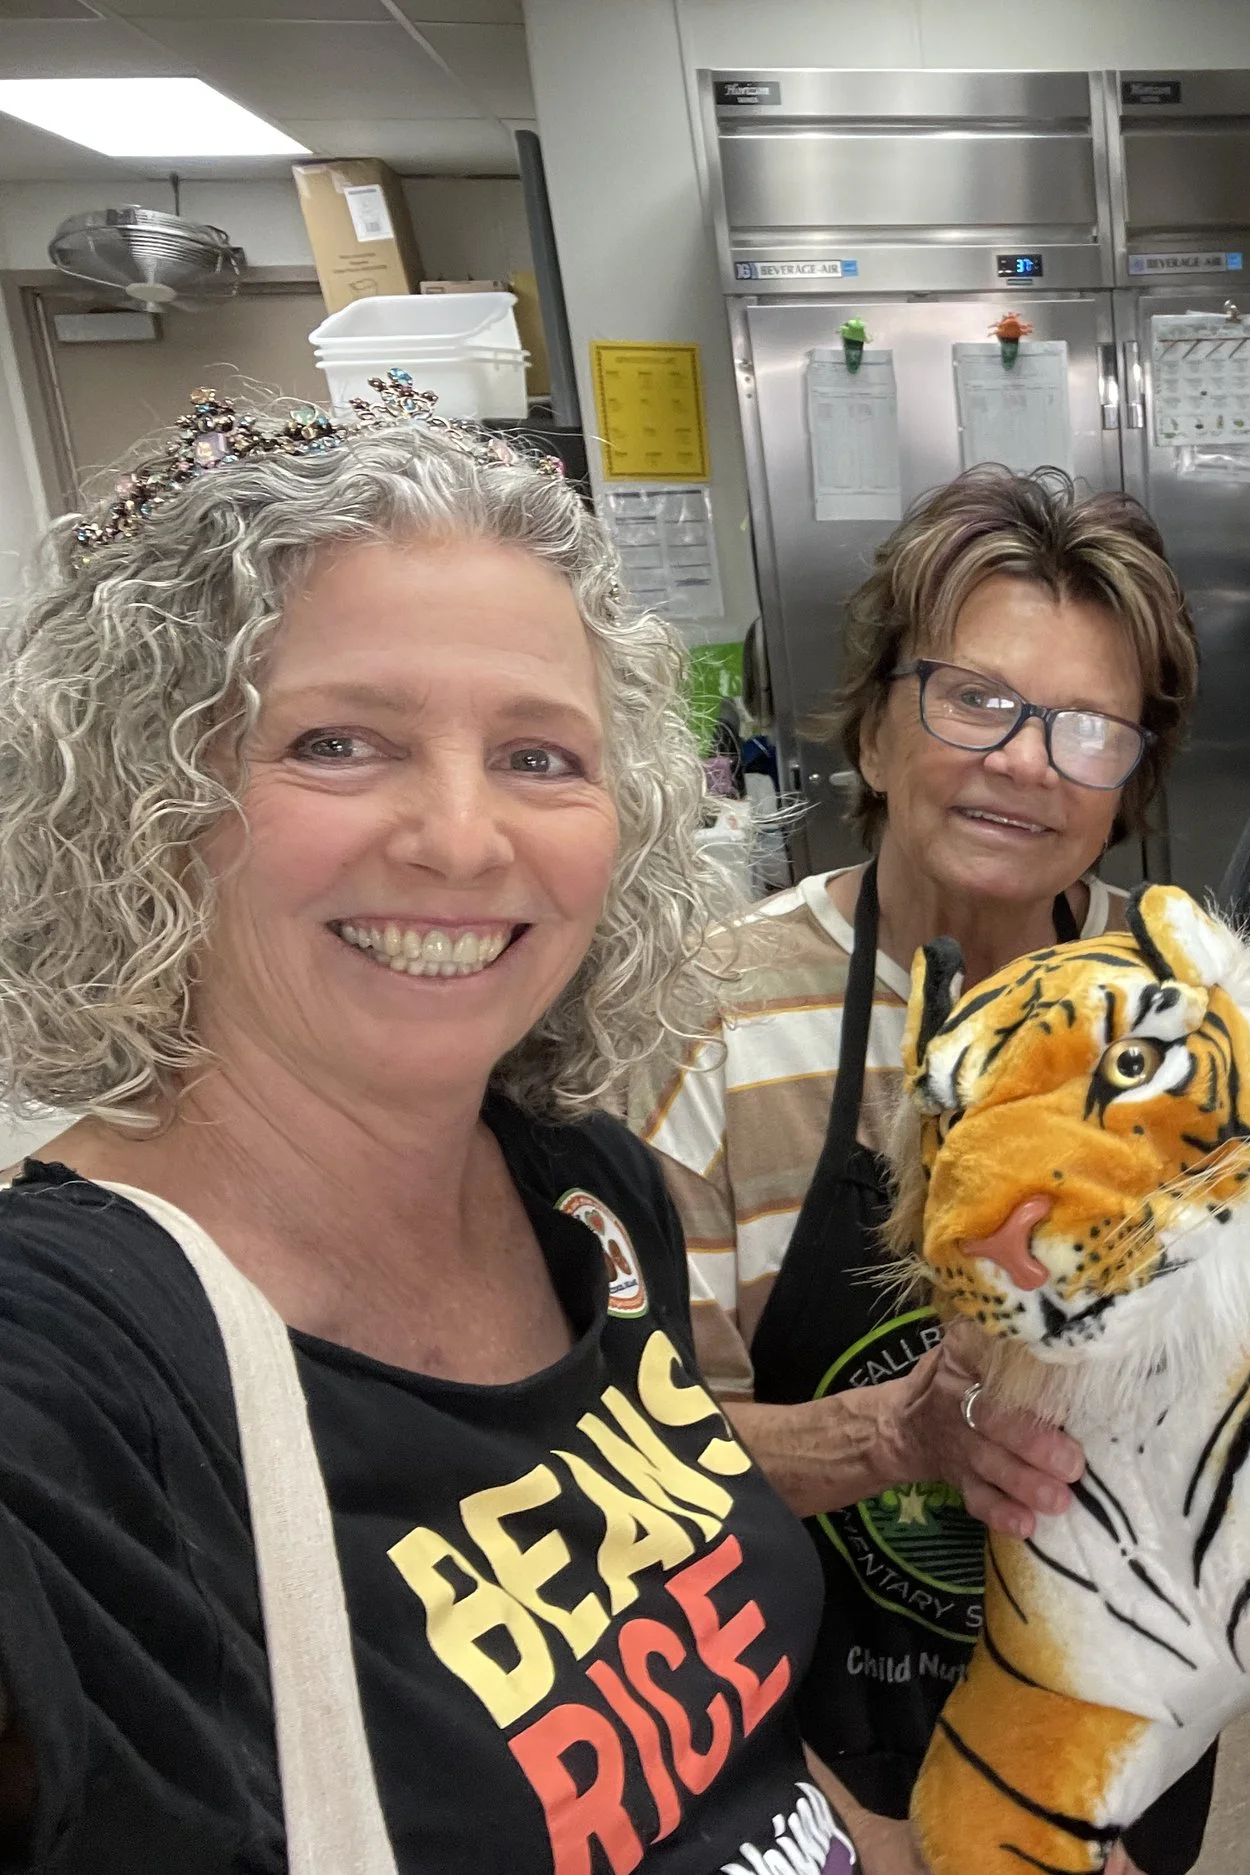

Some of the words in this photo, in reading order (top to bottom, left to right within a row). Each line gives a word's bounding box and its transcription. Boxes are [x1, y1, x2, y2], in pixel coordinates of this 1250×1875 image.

[386, 1330, 752, 1729] BEANS
[847, 1645, 911, 1683] Child
[507, 1533, 792, 1875] RICE
